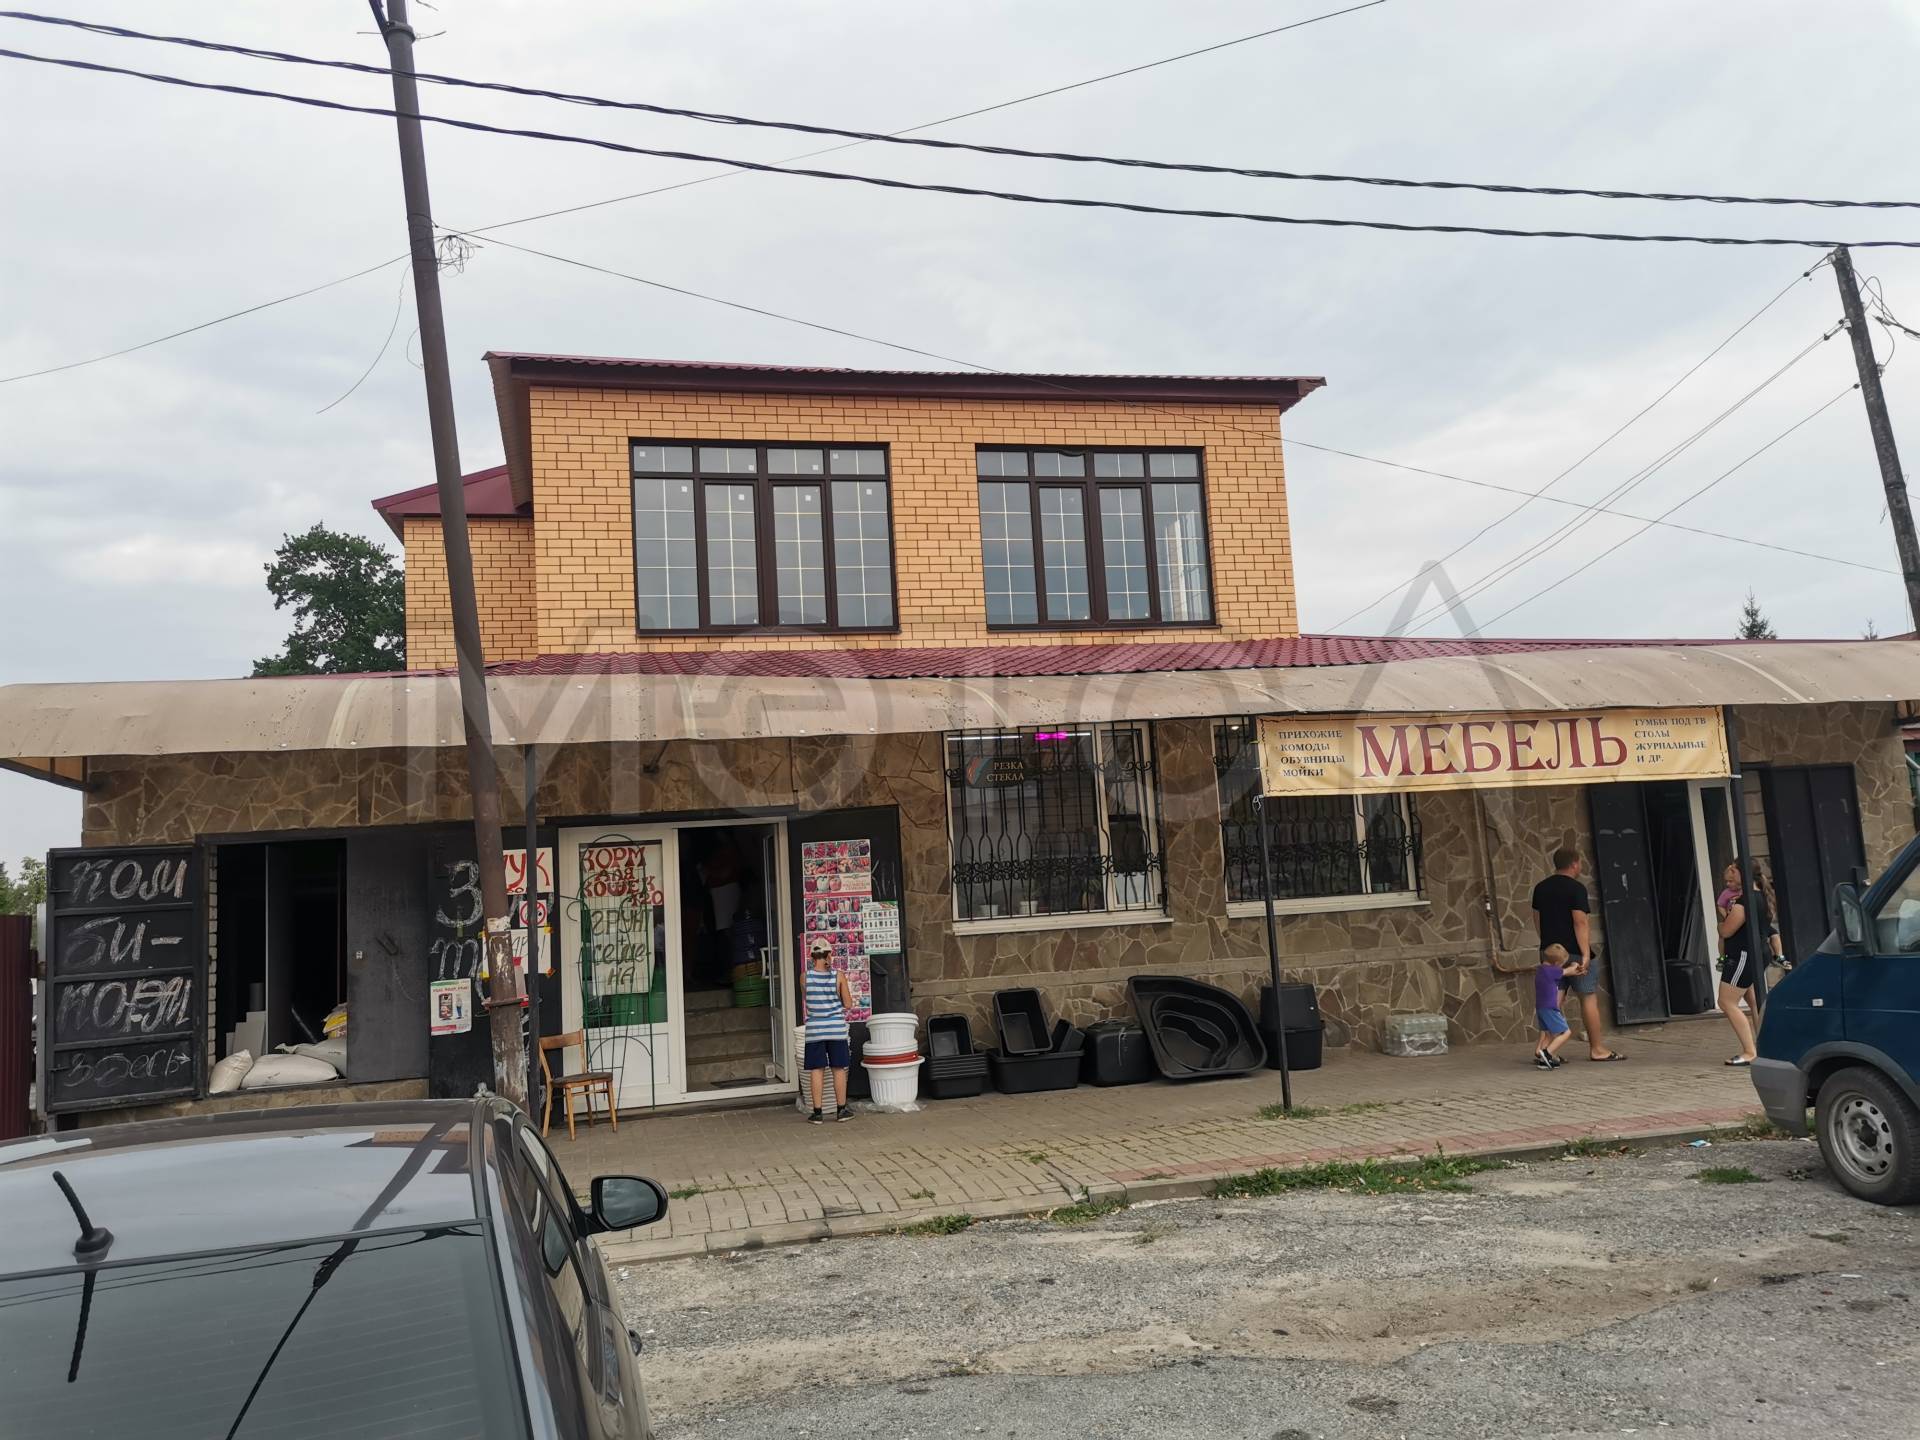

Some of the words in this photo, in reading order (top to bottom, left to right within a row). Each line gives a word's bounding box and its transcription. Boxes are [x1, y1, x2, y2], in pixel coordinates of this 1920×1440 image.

[1633, 718, 1668, 727] ТУМБЫ
[1671, 717, 1691, 727] ПОД
[1695, 717, 1707, 725] ТВ
[1278, 730, 1343, 740] ПРИХОЖИЕ
[1634, 730, 1670, 738] СТОЛЫ
[1280, 743, 1330, 752] КОМОДЫ
[1356, 717, 1628, 778] МЕБЕЛЬ
[1635, 741, 1706, 751] ЖУРНАЛЬНЫЕ
[1280, 755, 1345, 765] ОБУВНИЦЫ
[1637, 755, 1644, 763] И
[993, 761, 1024, 770] РЕЗКА
[1283, 766, 1324, 777] МОЙКИ
[986, 772, 1025, 782] СТЕКЛА
